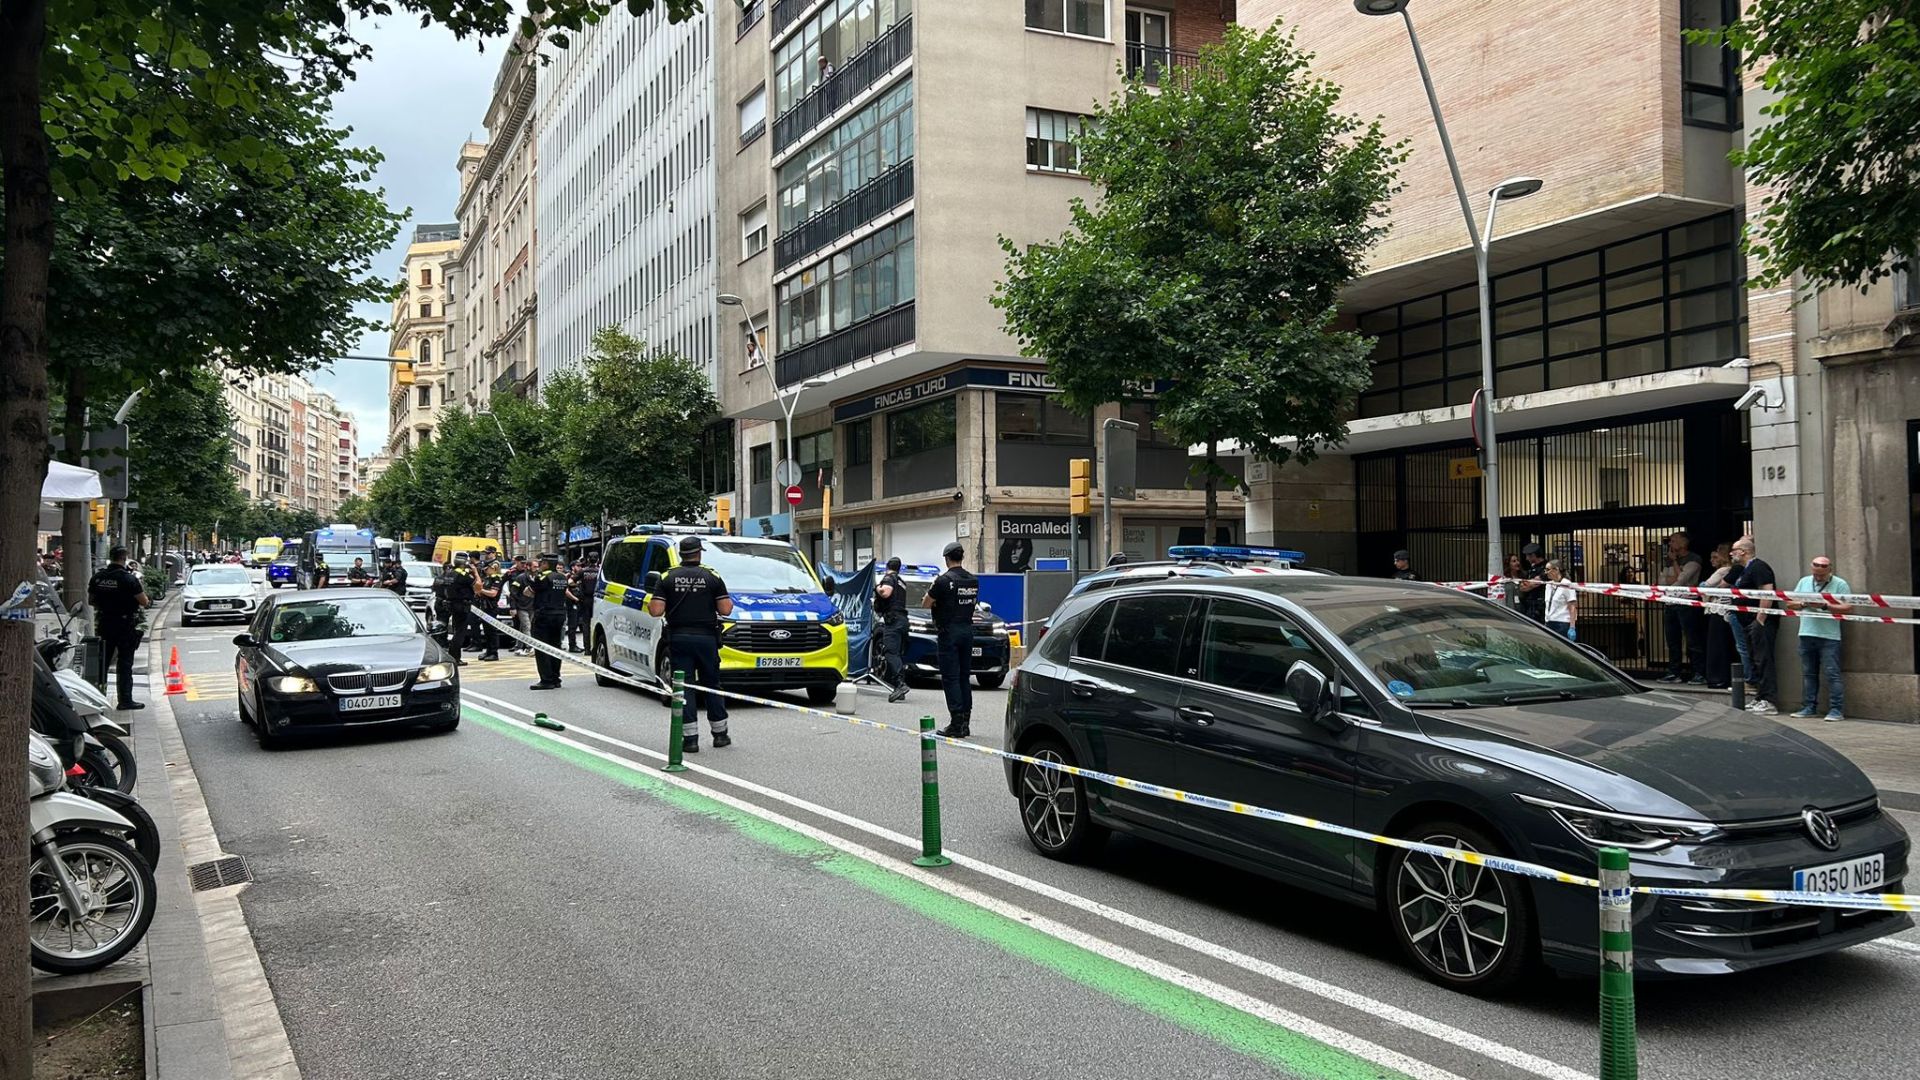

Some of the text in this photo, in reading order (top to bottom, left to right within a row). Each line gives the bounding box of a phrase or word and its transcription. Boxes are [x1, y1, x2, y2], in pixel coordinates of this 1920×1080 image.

[875, 375, 947, 409] FINCAS TURÓ
[1761, 465, 1786, 480] 192
[675, 577, 706, 585] POLICIA
[761, 657, 801, 666] 6788 NFZ
[347, 696, 399, 709] 0407 DYS
[1807, 860, 1881, 892] 0350 NBB
